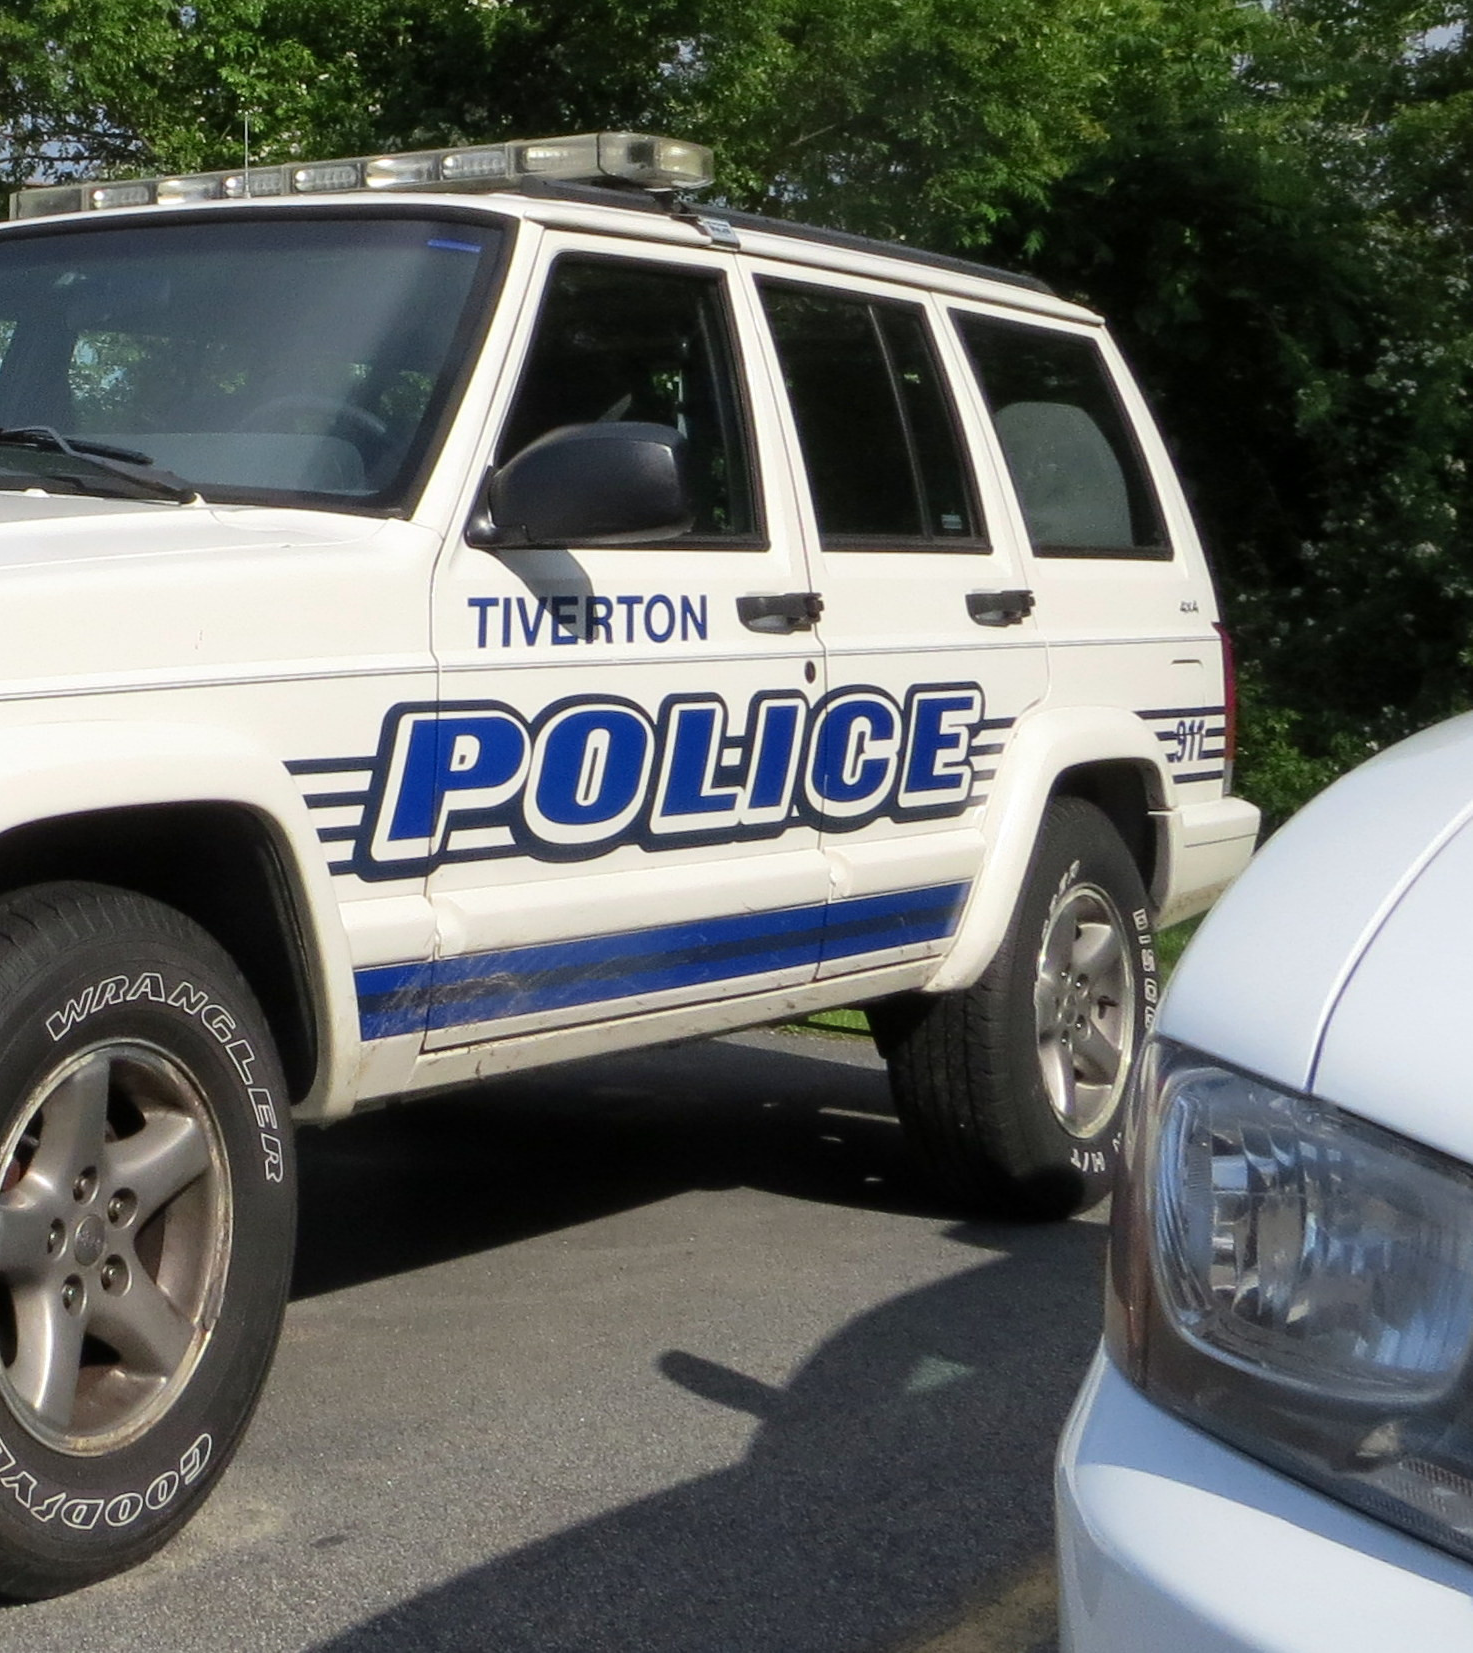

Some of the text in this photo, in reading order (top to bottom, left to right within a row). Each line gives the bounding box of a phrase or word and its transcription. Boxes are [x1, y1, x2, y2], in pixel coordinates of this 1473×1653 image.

[466, 593, 709, 650] TIVERTON
[369, 684, 983, 866] POLICE
[1175, 719, 1206, 764] 911
[45, 972, 285, 1184] WRANGLER
